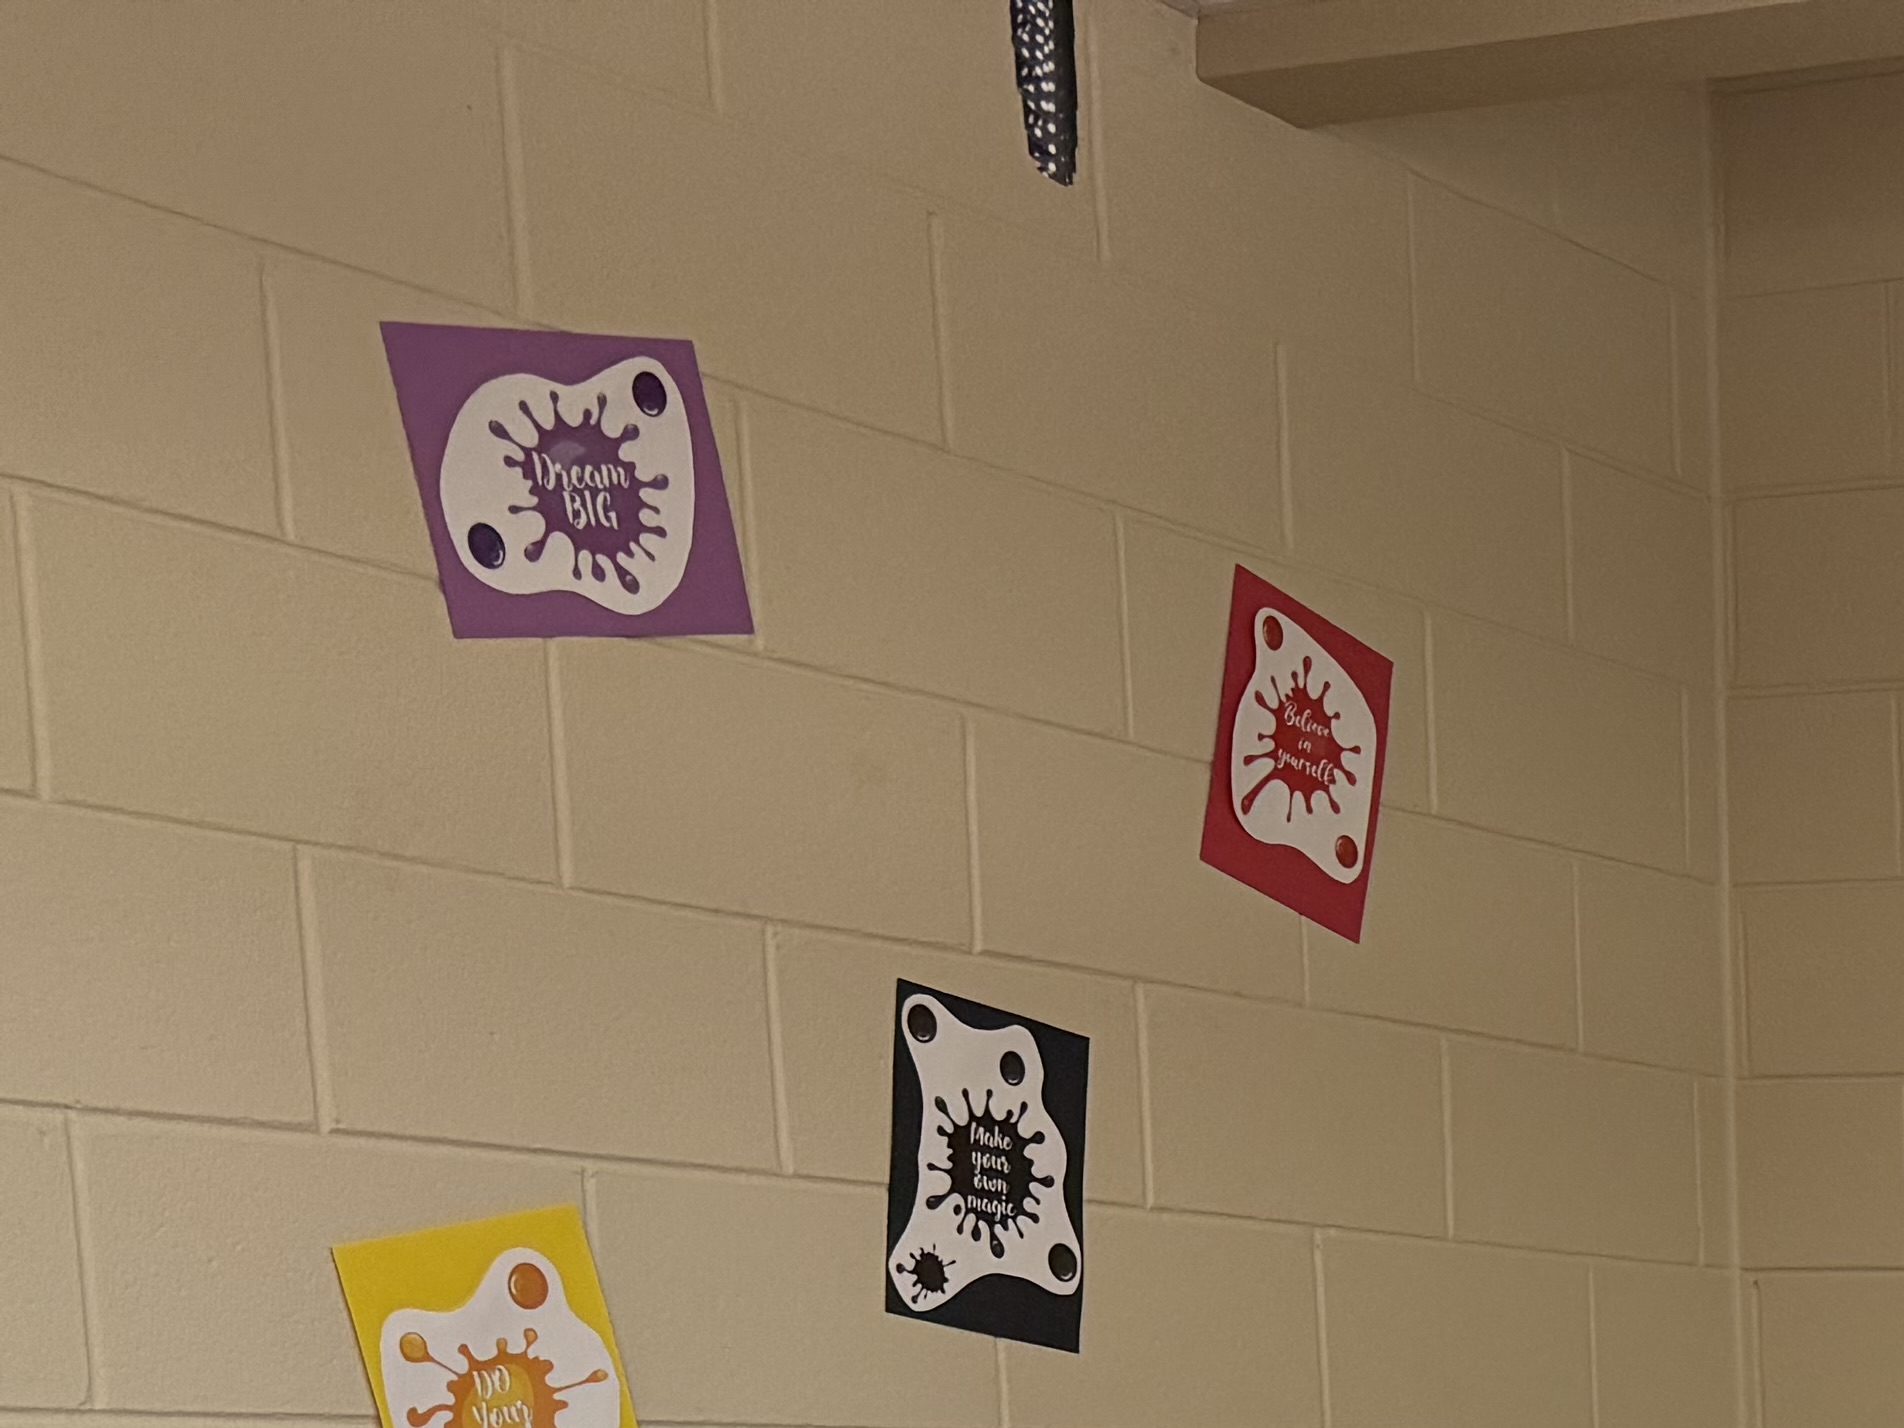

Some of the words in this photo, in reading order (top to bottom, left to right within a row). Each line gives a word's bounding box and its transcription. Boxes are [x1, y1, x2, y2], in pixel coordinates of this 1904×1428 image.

[531, 450, 630, 491] Dream
[562, 490, 619, 530] BIG
[1284, 701, 1330, 737] Believe
[1298, 737, 1312, 753] in
[1277, 748, 1334, 785] yourself
[970, 1121, 1013, 1150] Make
[972, 1151, 1012, 1174] your
[973, 1174, 1010, 1194] own
[967, 1195, 1016, 1221] magic
